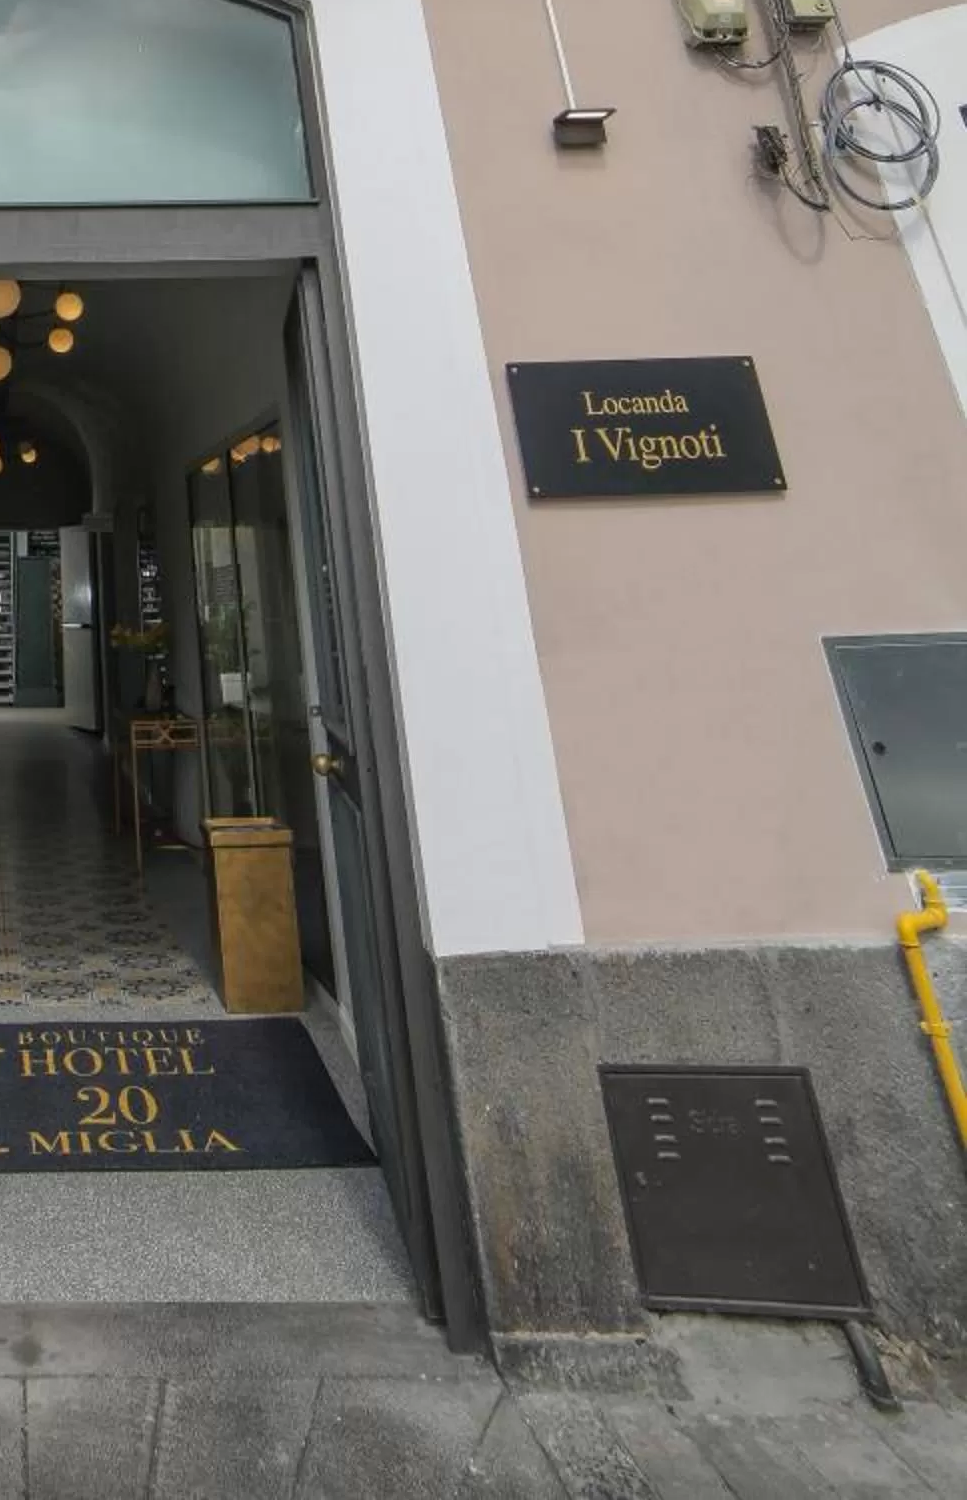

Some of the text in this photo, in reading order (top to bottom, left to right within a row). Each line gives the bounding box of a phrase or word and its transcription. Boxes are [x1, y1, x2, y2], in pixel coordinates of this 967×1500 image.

[581, 389, 689, 415] Locanda
[570, 424, 727, 470] I Vignoti
[18, 1028, 205, 1047] BOUTIQUE
[20, 1046, 216, 1077] HOTEL
[77, 1085, 160, 1126] 20
[31, 1130, 246, 1156] MIGLIA
